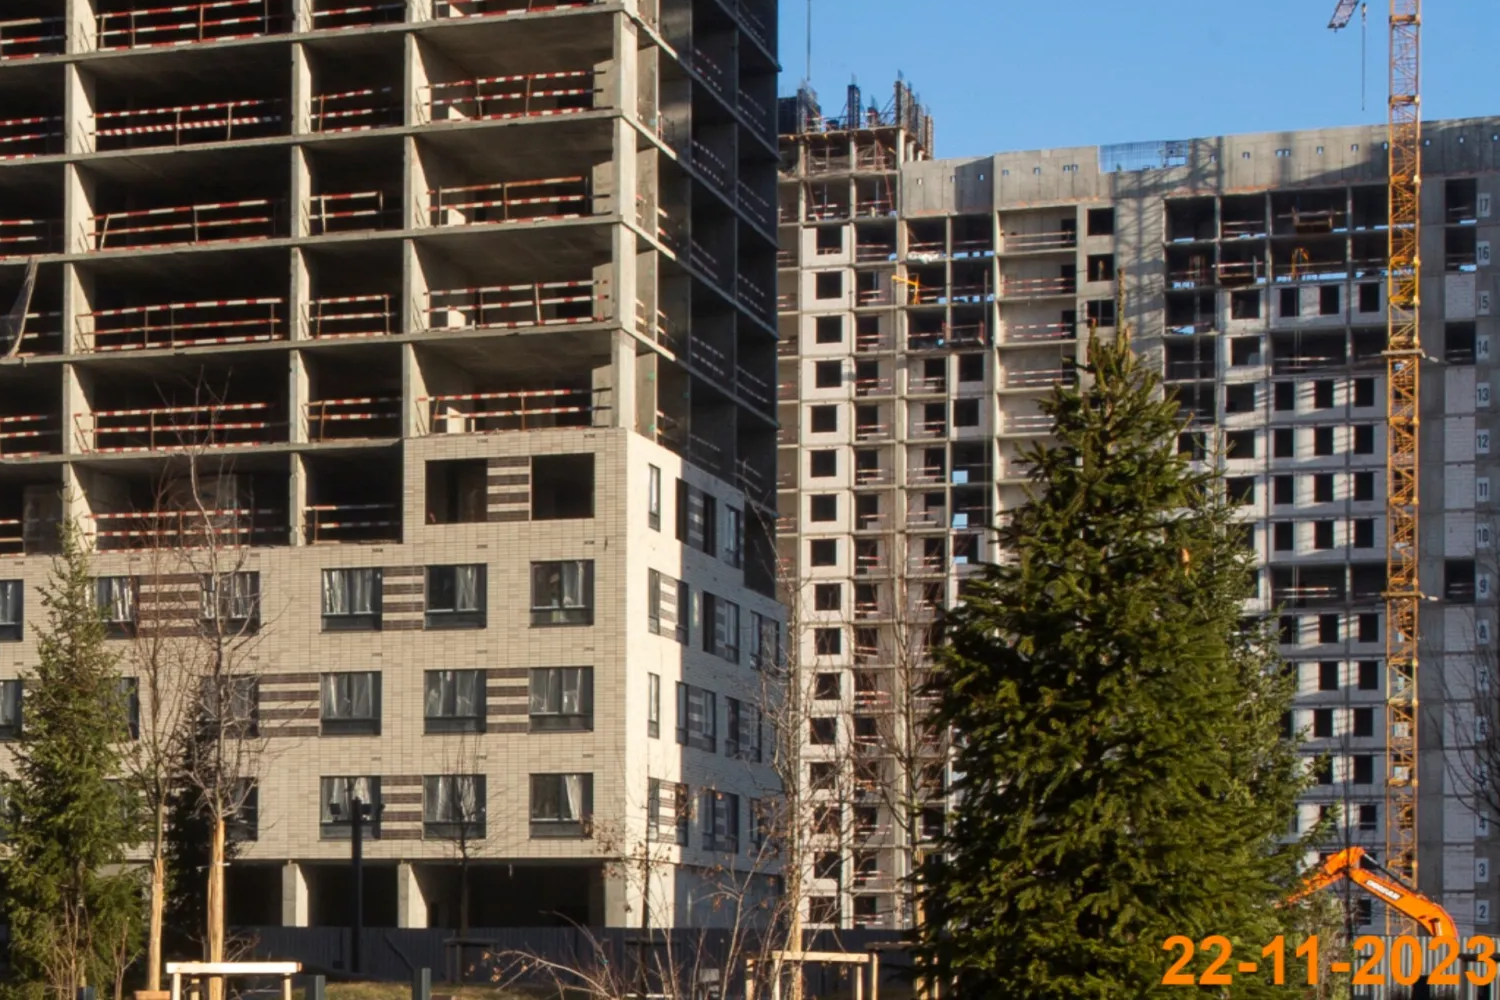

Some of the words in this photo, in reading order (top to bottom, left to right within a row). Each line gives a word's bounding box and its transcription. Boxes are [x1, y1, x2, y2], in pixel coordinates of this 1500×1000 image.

[1478, 246, 1490, 260] 16
[1477, 340, 1488, 354] 14
[1477, 387, 1489, 401] 13
[1477, 434, 1488, 448] 12
[1479, 482, 1488, 497] 11
[1478, 528, 1489, 543] 10
[1478, 862, 1486, 877] 3
[1479, 904, 1486, 919] 2
